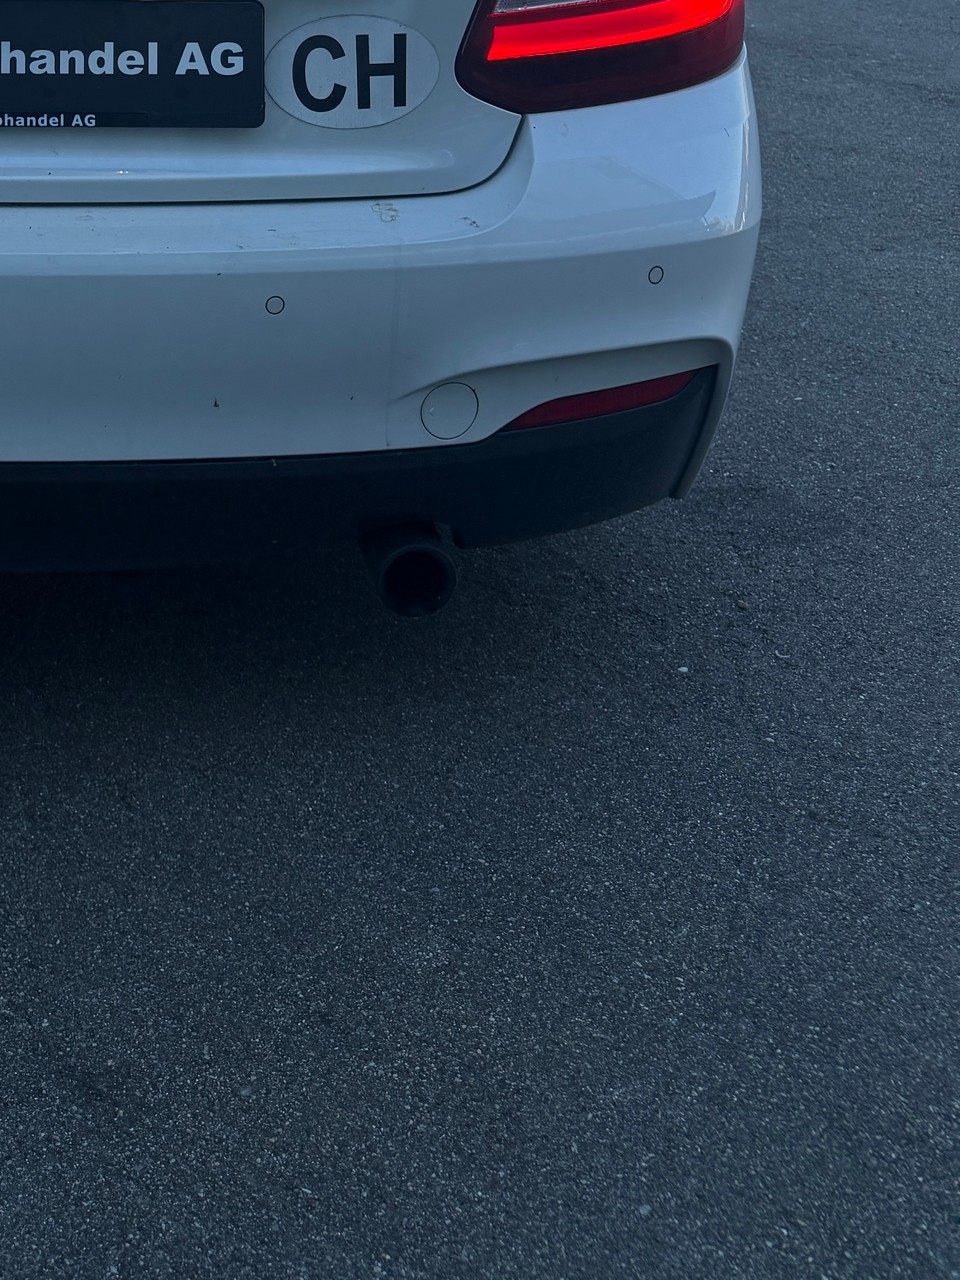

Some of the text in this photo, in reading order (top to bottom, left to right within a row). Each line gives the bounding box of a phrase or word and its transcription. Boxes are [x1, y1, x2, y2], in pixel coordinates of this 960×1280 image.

[174, 41, 244, 77] AG
[292, 33, 407, 113] CH
[71, 114, 96, 127] AG
